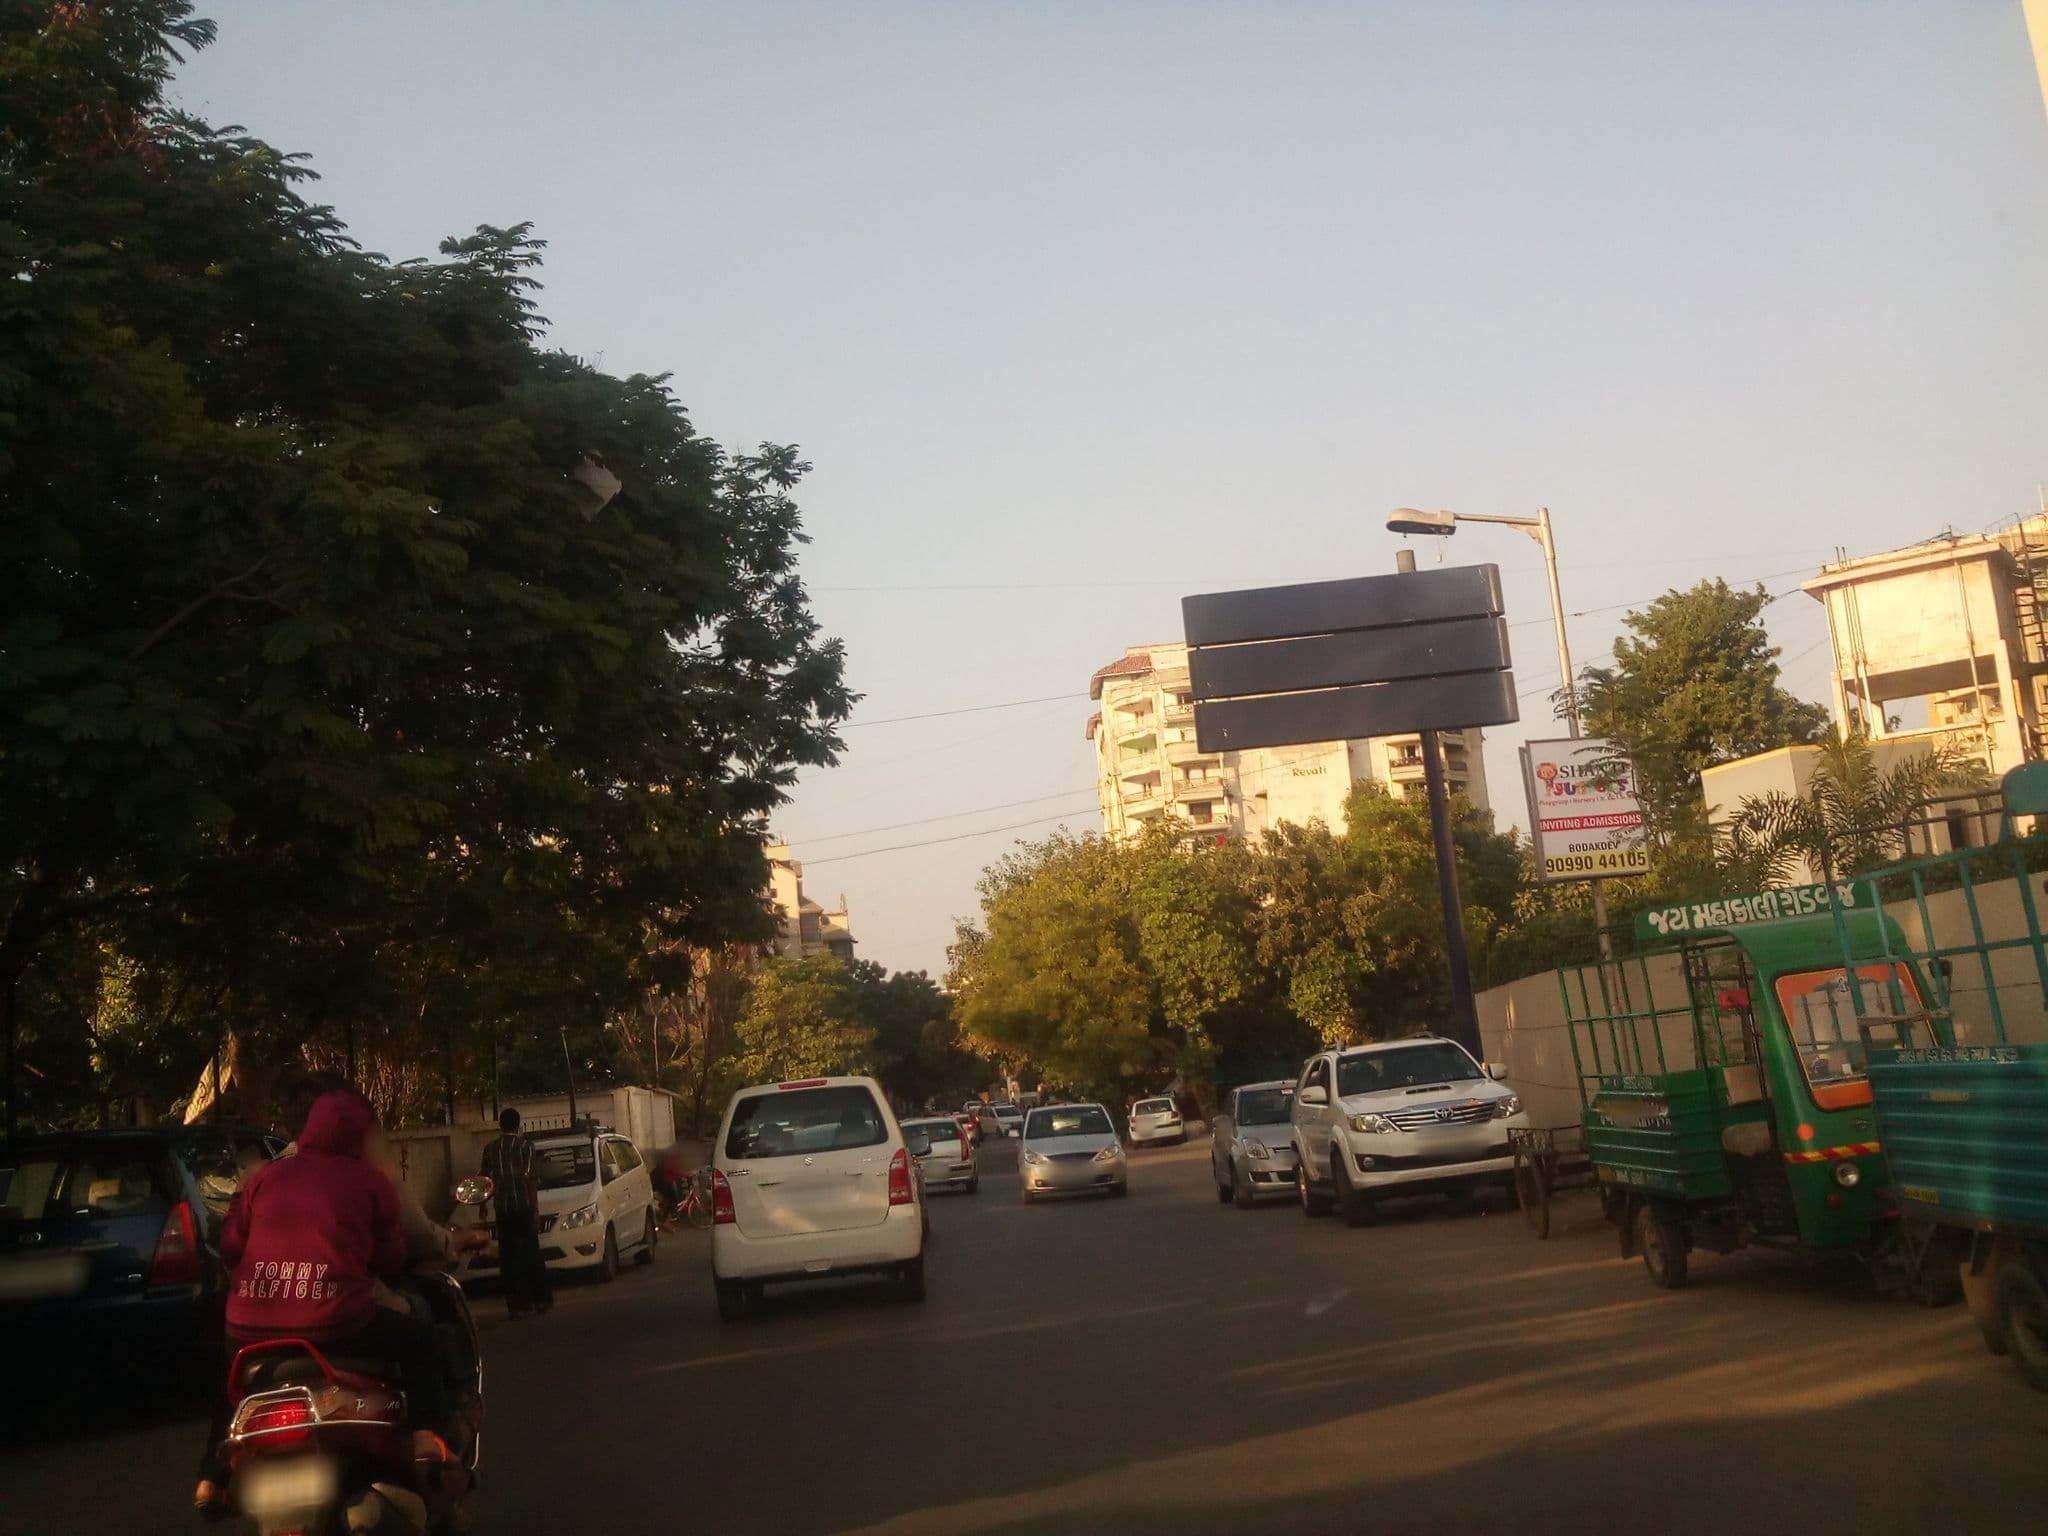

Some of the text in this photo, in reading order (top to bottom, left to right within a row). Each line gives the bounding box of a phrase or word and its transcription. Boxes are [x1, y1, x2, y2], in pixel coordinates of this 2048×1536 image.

[1540, 814, 1642, 831] INVITING ADMISSIONS
[1569, 841, 1618, 853] BODAKDEV
[1546, 851, 1646, 873] 90990 44105
[1648, 907, 1690, 934] જય
[254, 1261, 328, 1280] TOMMY
